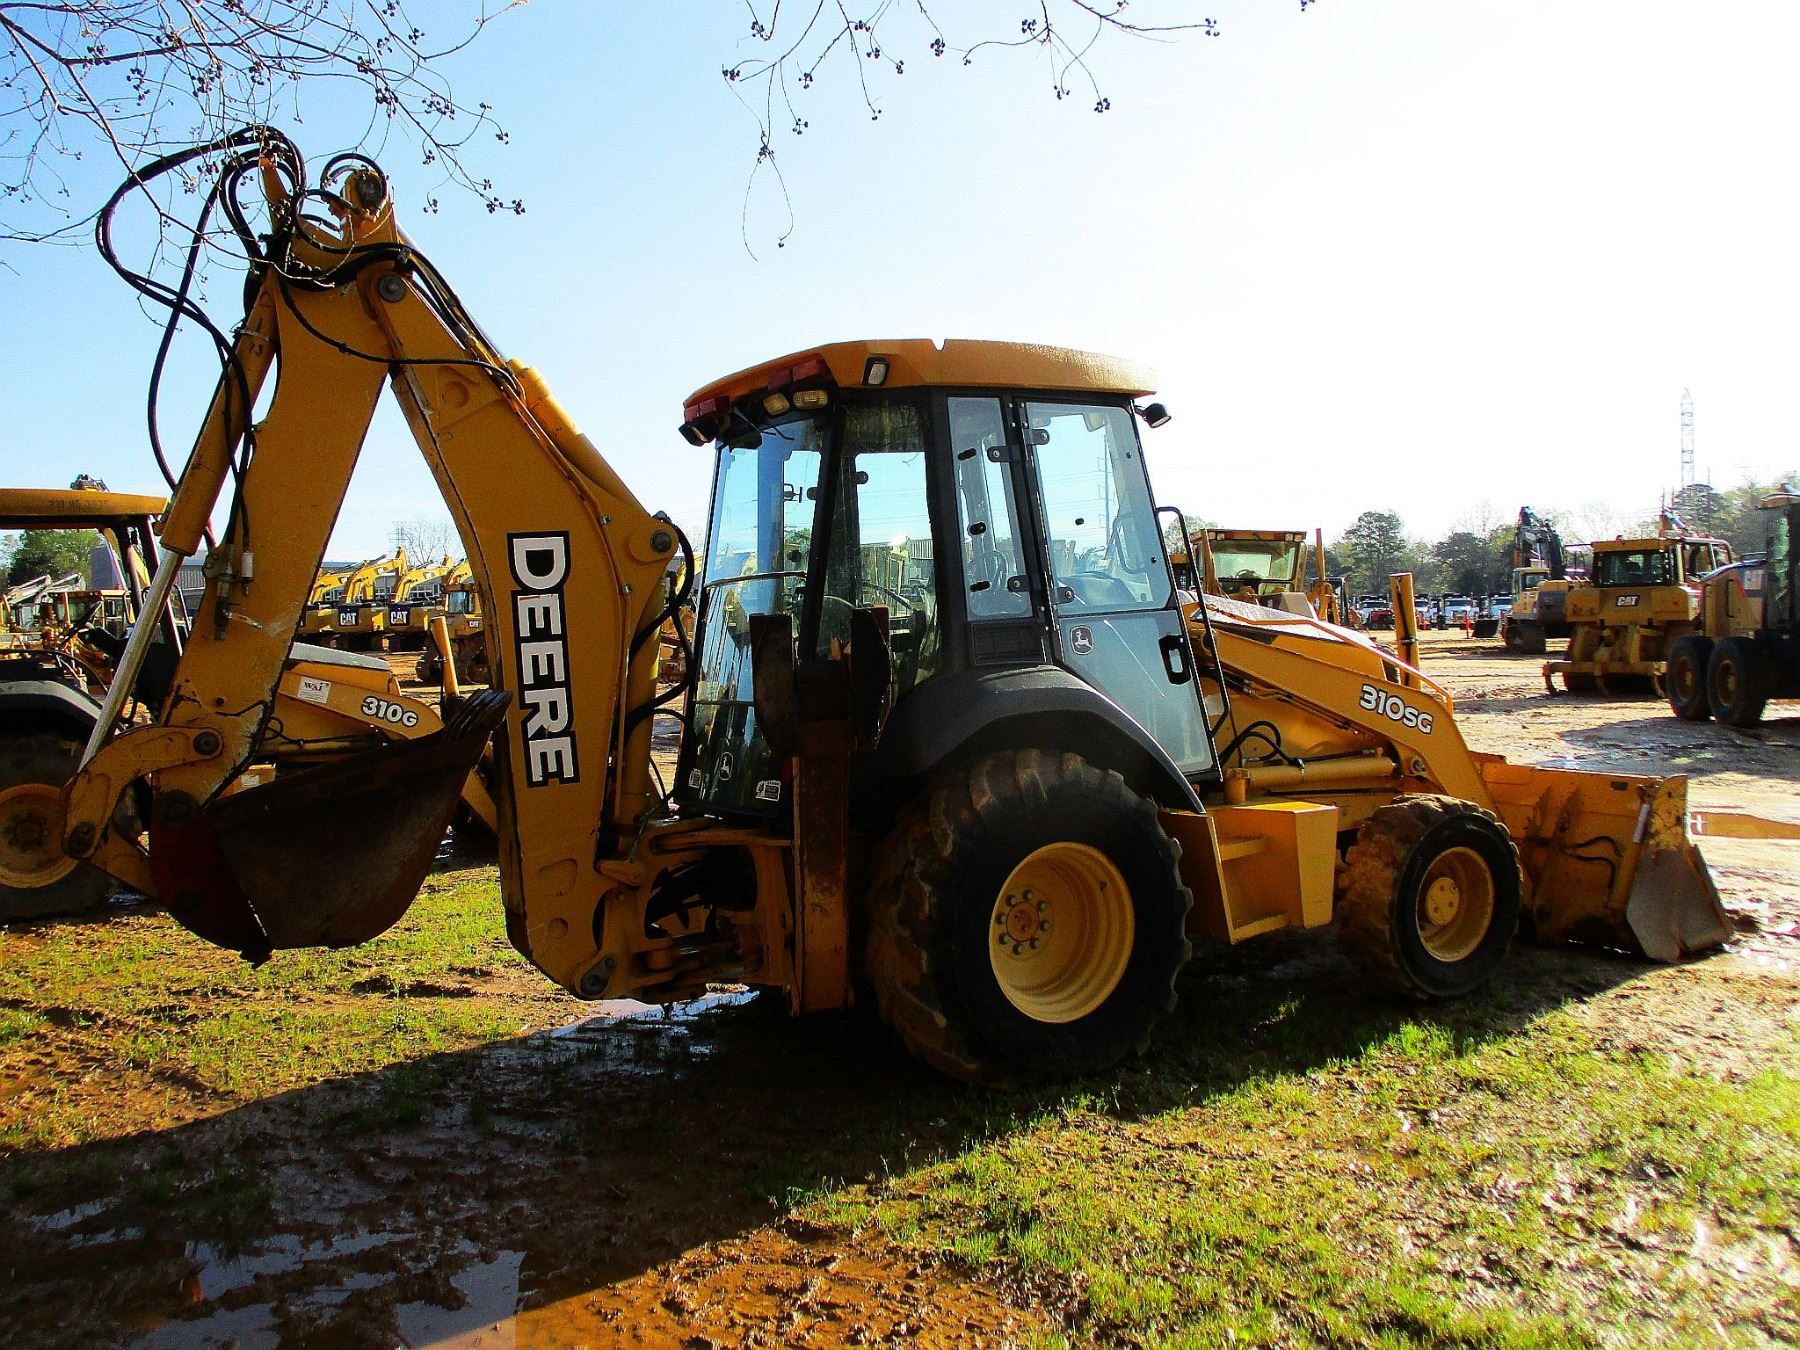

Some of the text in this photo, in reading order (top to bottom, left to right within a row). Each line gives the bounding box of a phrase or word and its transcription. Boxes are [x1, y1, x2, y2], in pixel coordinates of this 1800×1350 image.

[1617, 596, 1637, 606] CAT
[340, 612, 356, 625] CAT
[390, 611, 407, 624] CAT
[510, 534, 577, 785] DEERE
[362, 697, 418, 726] 310G
[1360, 684, 1433, 733] 310SG
